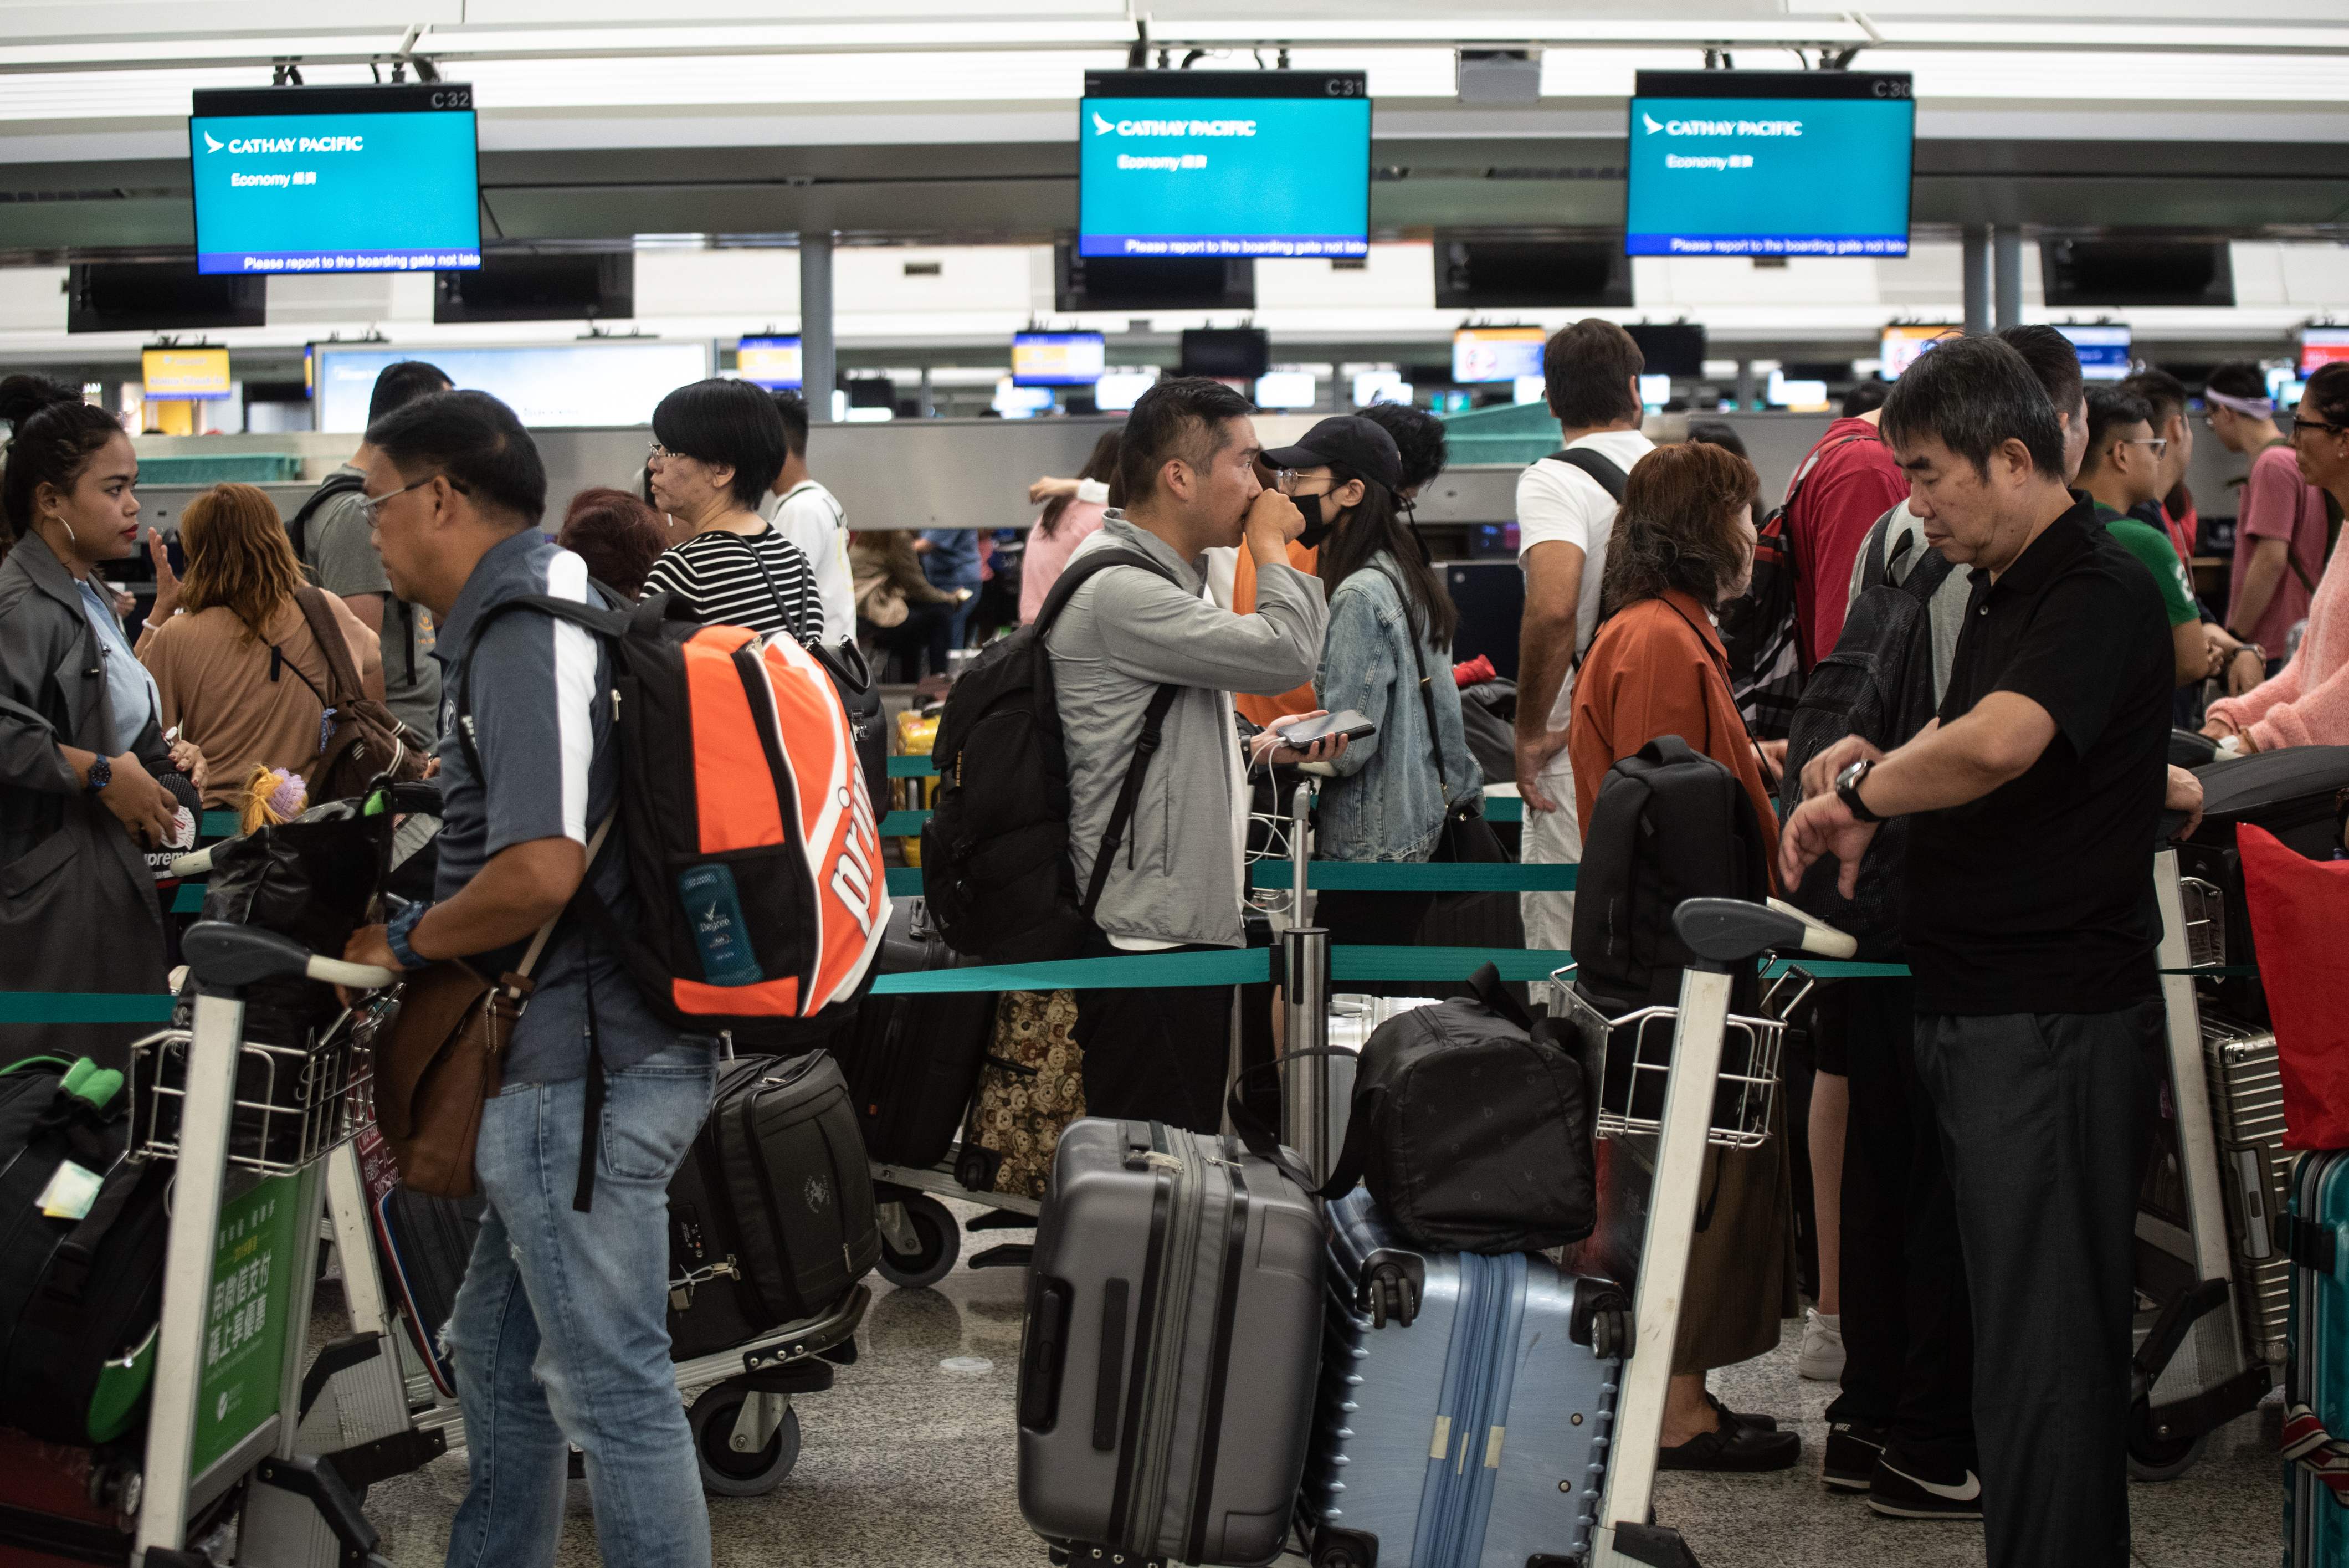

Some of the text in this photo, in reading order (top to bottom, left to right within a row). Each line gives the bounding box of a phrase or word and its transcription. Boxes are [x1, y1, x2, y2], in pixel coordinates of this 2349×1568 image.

[1116, 121, 1256, 136] CATHAY PACIFIC
[1666, 121, 1803, 136] CATHAY PACIFIC
[228, 136, 363, 153] CATHAY PACIFIC
[1117, 155, 1181, 171] Economy
[1665, 154, 1727, 171] Economy
[231, 172, 290, 187] Economy
[1125, 239, 1167, 254] Please
[1170, 240, 1205, 255] report
[1207, 240, 1220, 254] to
[1222, 239, 1240, 254] the
[1243, 239, 1294, 255] boarding
[1295, 242, 1322, 255] gate
[1324, 240, 1343, 253] not
[1670, 238, 1713, 252] Please
[1714, 240, 1749, 254] report
[1750, 239, 1763, 252] to
[1765, 238, 1784, 252] the
[1786, 238, 1835, 254] boarding
[1838, 240, 1863, 254] gate
[1865, 239, 1885, 252] not
[244, 257, 284, 270] Please
[286, 257, 320, 271] report
[322, 256, 334, 269] to
[336, 255, 355, 268] the
[357, 254, 408, 269] boarding
[410, 257, 436, 269] gate
[438, 255, 457, 266] not
[830, 730, 875, 940] prin
[144, 852, 192, 866] prem
[212, 1251, 272, 1322] 用微信支付
[1833, 1422, 1852, 1432] NIKE
